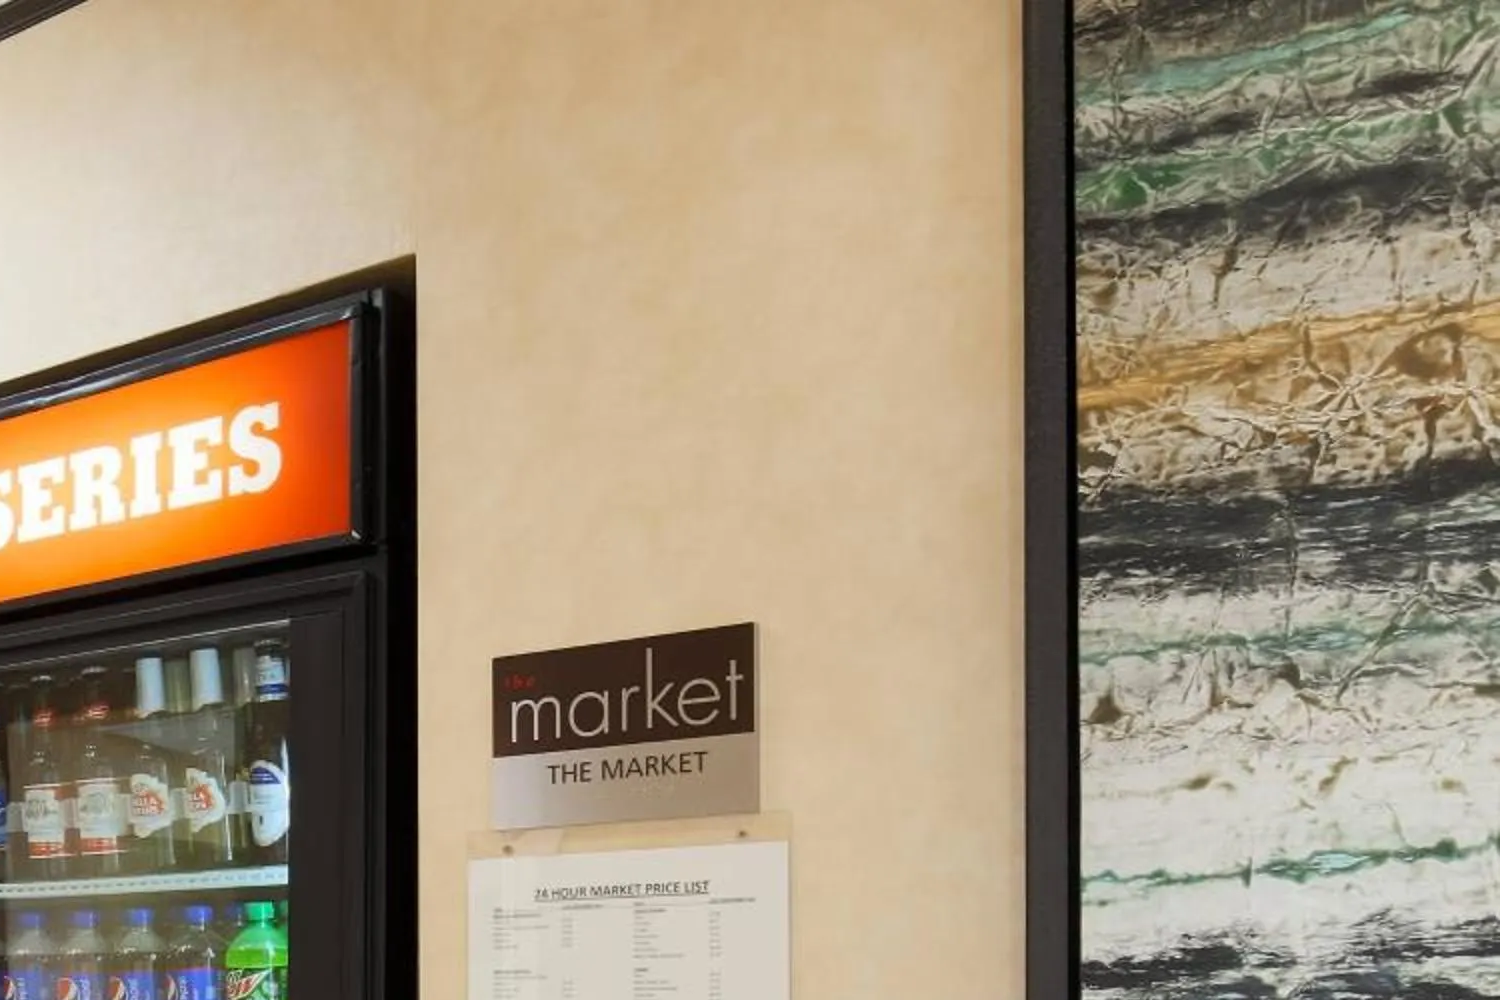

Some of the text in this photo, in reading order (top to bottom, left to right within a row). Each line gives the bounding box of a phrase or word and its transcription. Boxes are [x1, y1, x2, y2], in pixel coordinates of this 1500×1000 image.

[511, 647, 744, 743] market
[548, 751, 708, 785] THE MARKET
[552, 887, 588, 899] HOUR
[590, 884, 642, 897] MARKET
[645, 881, 680, 895] PRICE
[684, 880, 711, 894] LIST
